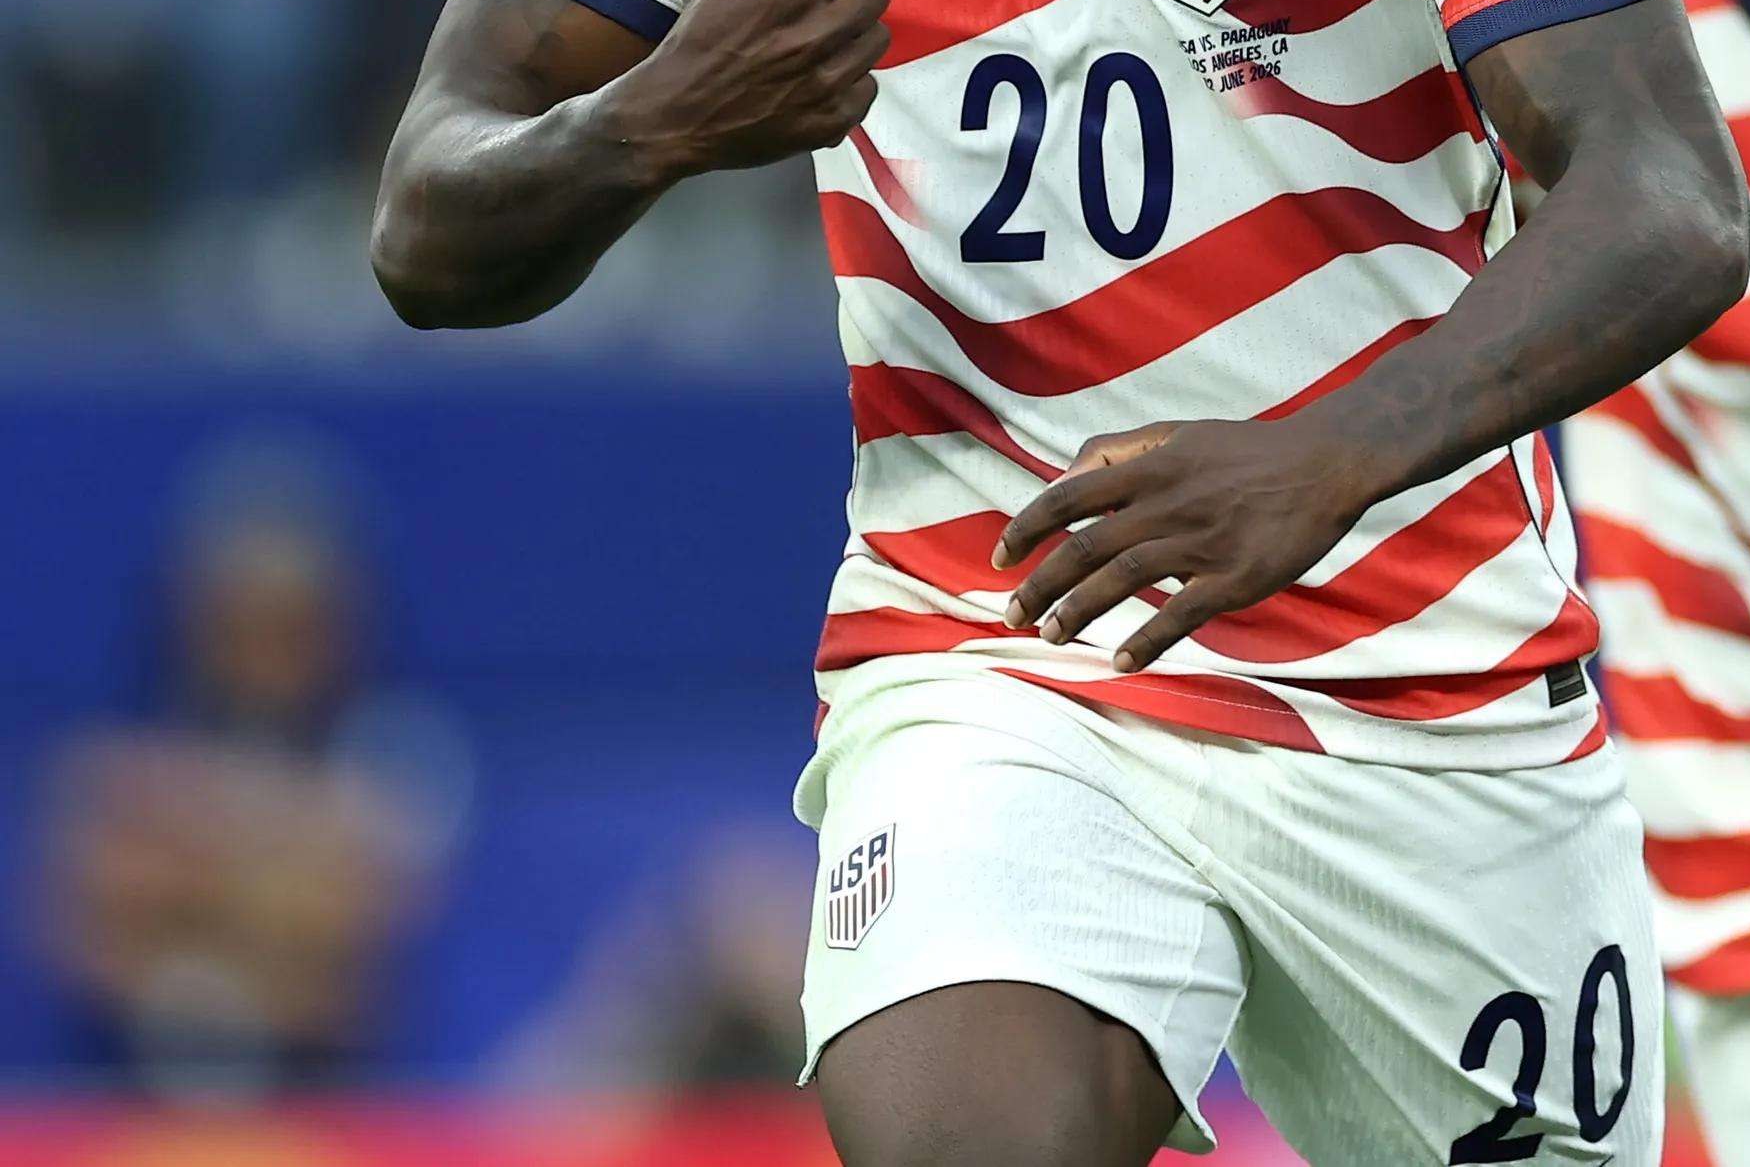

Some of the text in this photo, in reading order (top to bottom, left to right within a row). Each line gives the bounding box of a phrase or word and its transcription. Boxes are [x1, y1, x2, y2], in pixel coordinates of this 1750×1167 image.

[1178, 16, 1291, 54] SA VS. PARAGUAY
[1212, 44, 1267, 72] ANGELES,
[1272, 37, 1289, 56] CA
[1220, 69, 1245, 93] JUNE
[1249, 60, 1281, 83] 2026
[960, 51, 1174, 263] 20
[830, 832, 888, 893] USA
[1448, 943, 1635, 1167] 20
